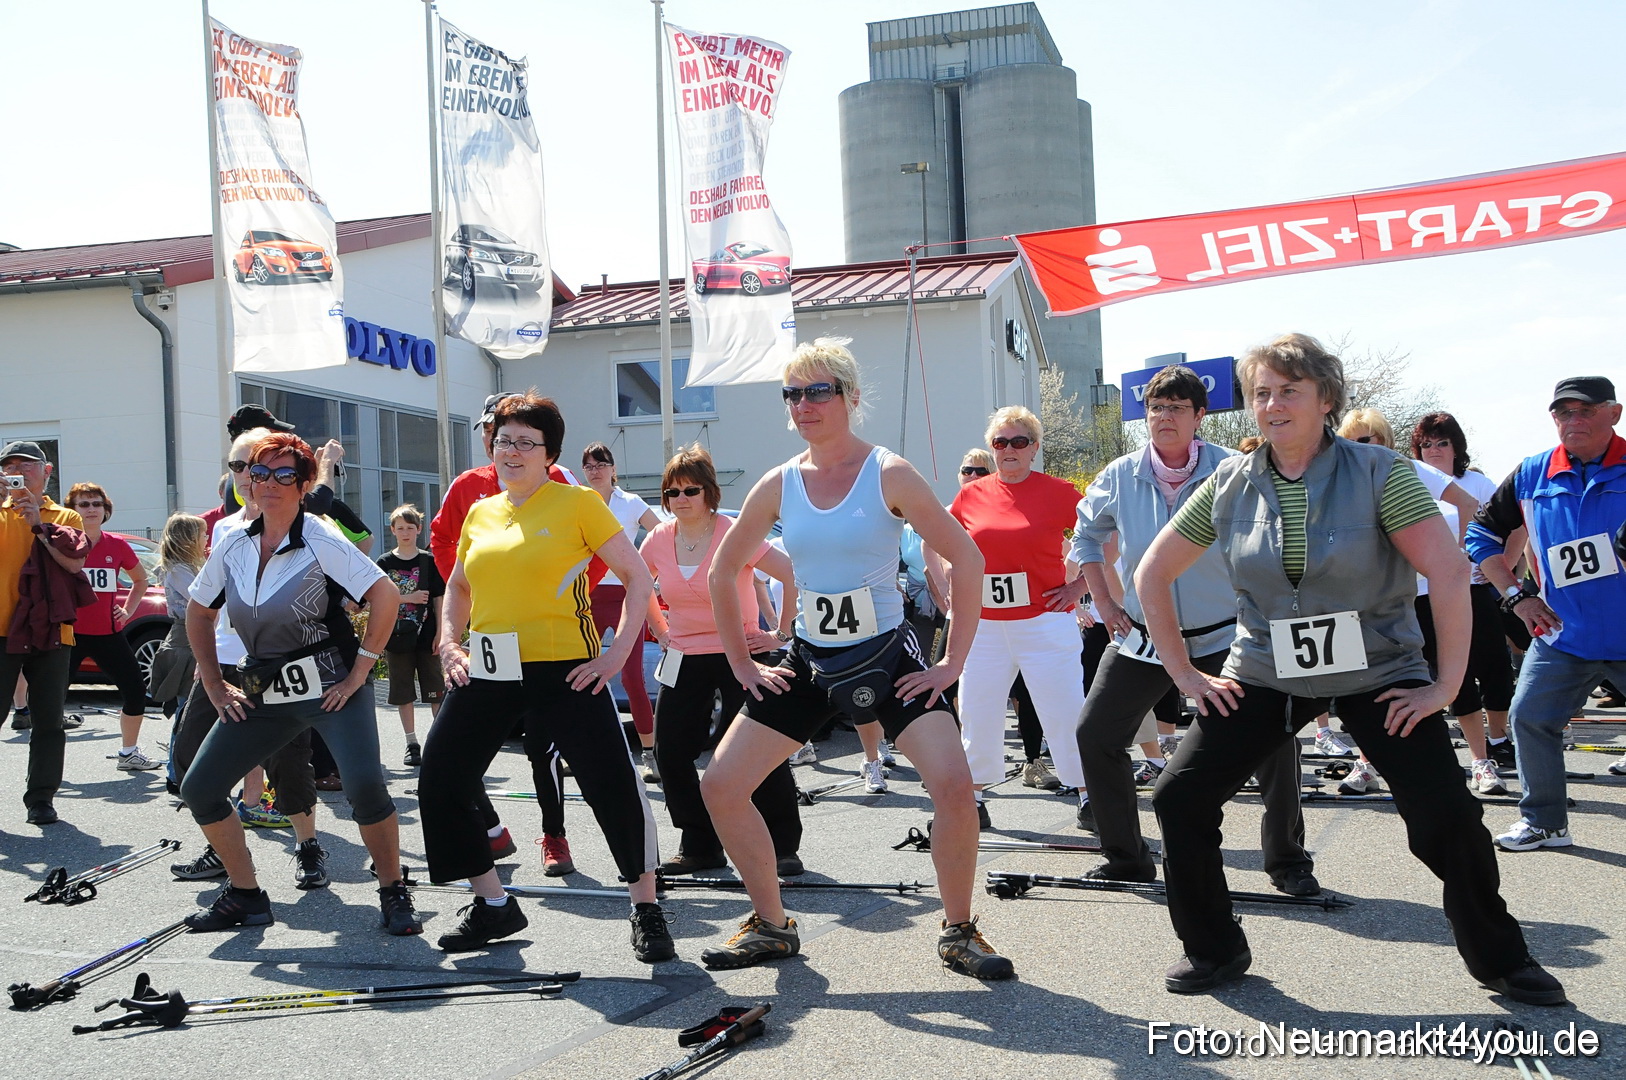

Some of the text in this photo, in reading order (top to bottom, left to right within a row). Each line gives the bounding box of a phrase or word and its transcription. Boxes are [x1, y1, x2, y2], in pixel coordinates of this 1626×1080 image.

[734, 37, 783, 71] MEHR
[444, 58, 461, 83] IM
[467, 64, 513, 93] EBEN
[679, 58, 700, 84] IM
[745, 62, 777, 94] ALS
[443, 86, 488, 114] EINEN
[682, 81, 731, 113] EINEN
[220, 188, 241, 205] DEN
[689, 182, 728, 206] DESHALB
[690, 193, 770, 224] DEN NEUEN VOLVO
[344, 316, 437, 377] OLVO
[1560, 541, 1600, 580] 29
[89, 569, 108, 589] 18
[991, 576, 1015, 604] 51
[816, 595, 860, 635] 24
[481, 636, 497, 674] 6
[1290, 617, 1336, 669] 57
[273, 664, 309, 697] 49
